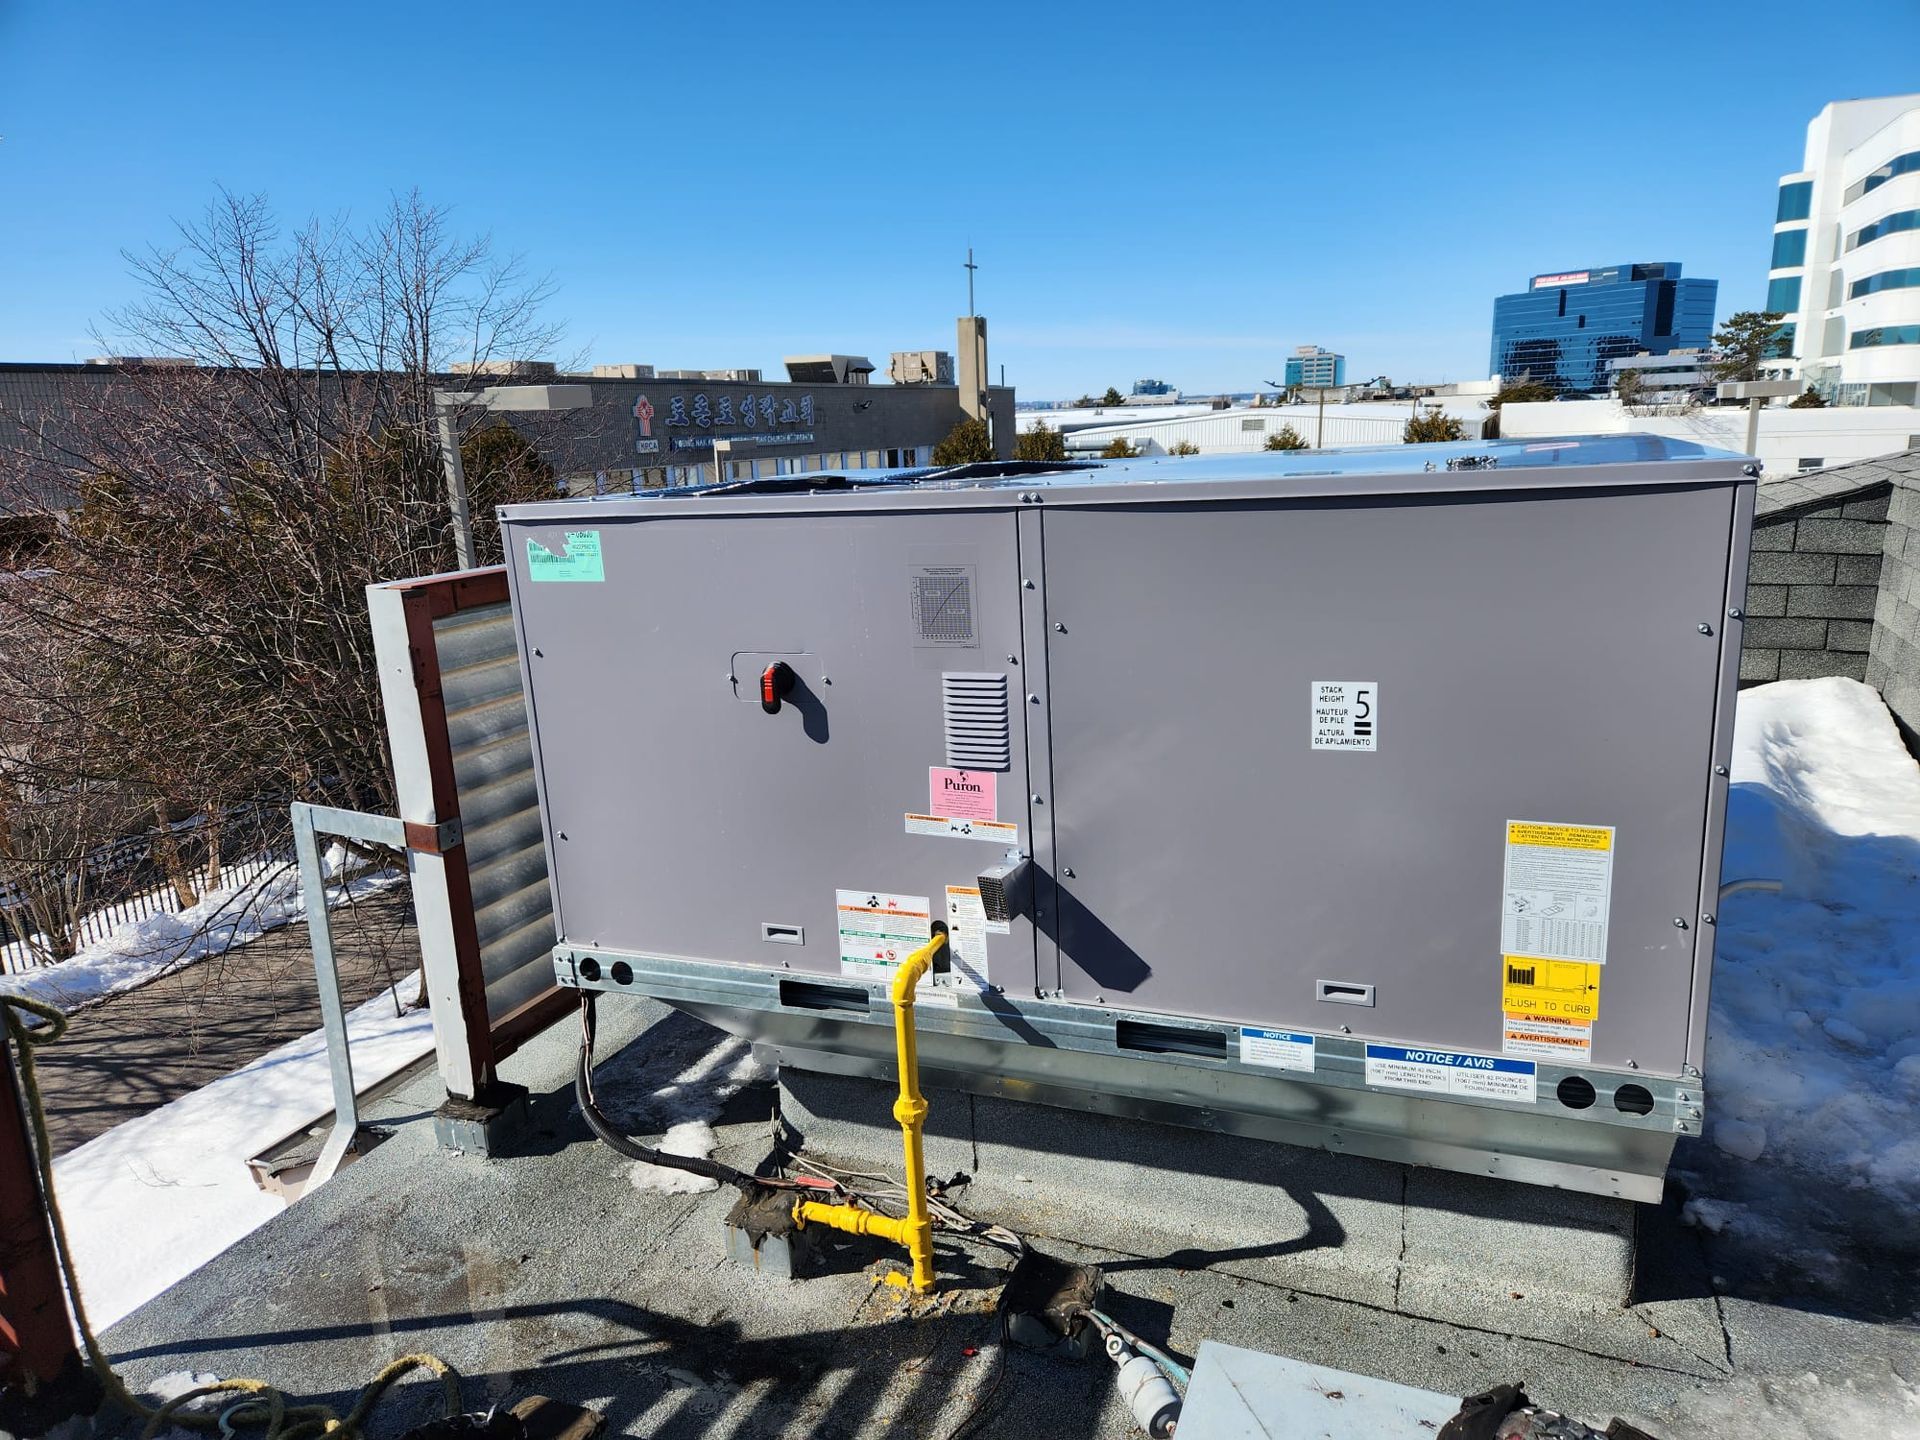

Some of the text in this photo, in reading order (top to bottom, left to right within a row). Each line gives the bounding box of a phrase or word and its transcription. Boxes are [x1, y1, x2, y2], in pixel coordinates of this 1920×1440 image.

[1319, 695, 1345, 703] HEIGHT
[1355, 691, 1370, 719] 5
[1316, 708, 1349, 716] HAUTEUR
[1319, 729, 1345, 737] ALTURA
[1325, 738, 1371, 746] APILAMIENTO
[944, 778, 981, 793] Puron
[1504, 998, 1591, 1014] FLUSH TO CURB
[1533, 1015, 1571, 1025] WARNING
[1263, 1031, 1292, 1041] NOTICE
[1520, 1034, 1583, 1046] AVERTISSEMENT
[1405, 1050, 1495, 1069] NOTICE / AVIS
[1400, 1071, 1424, 1079] LENGTH
[1487, 1081, 1518, 1089] MINIMUM
